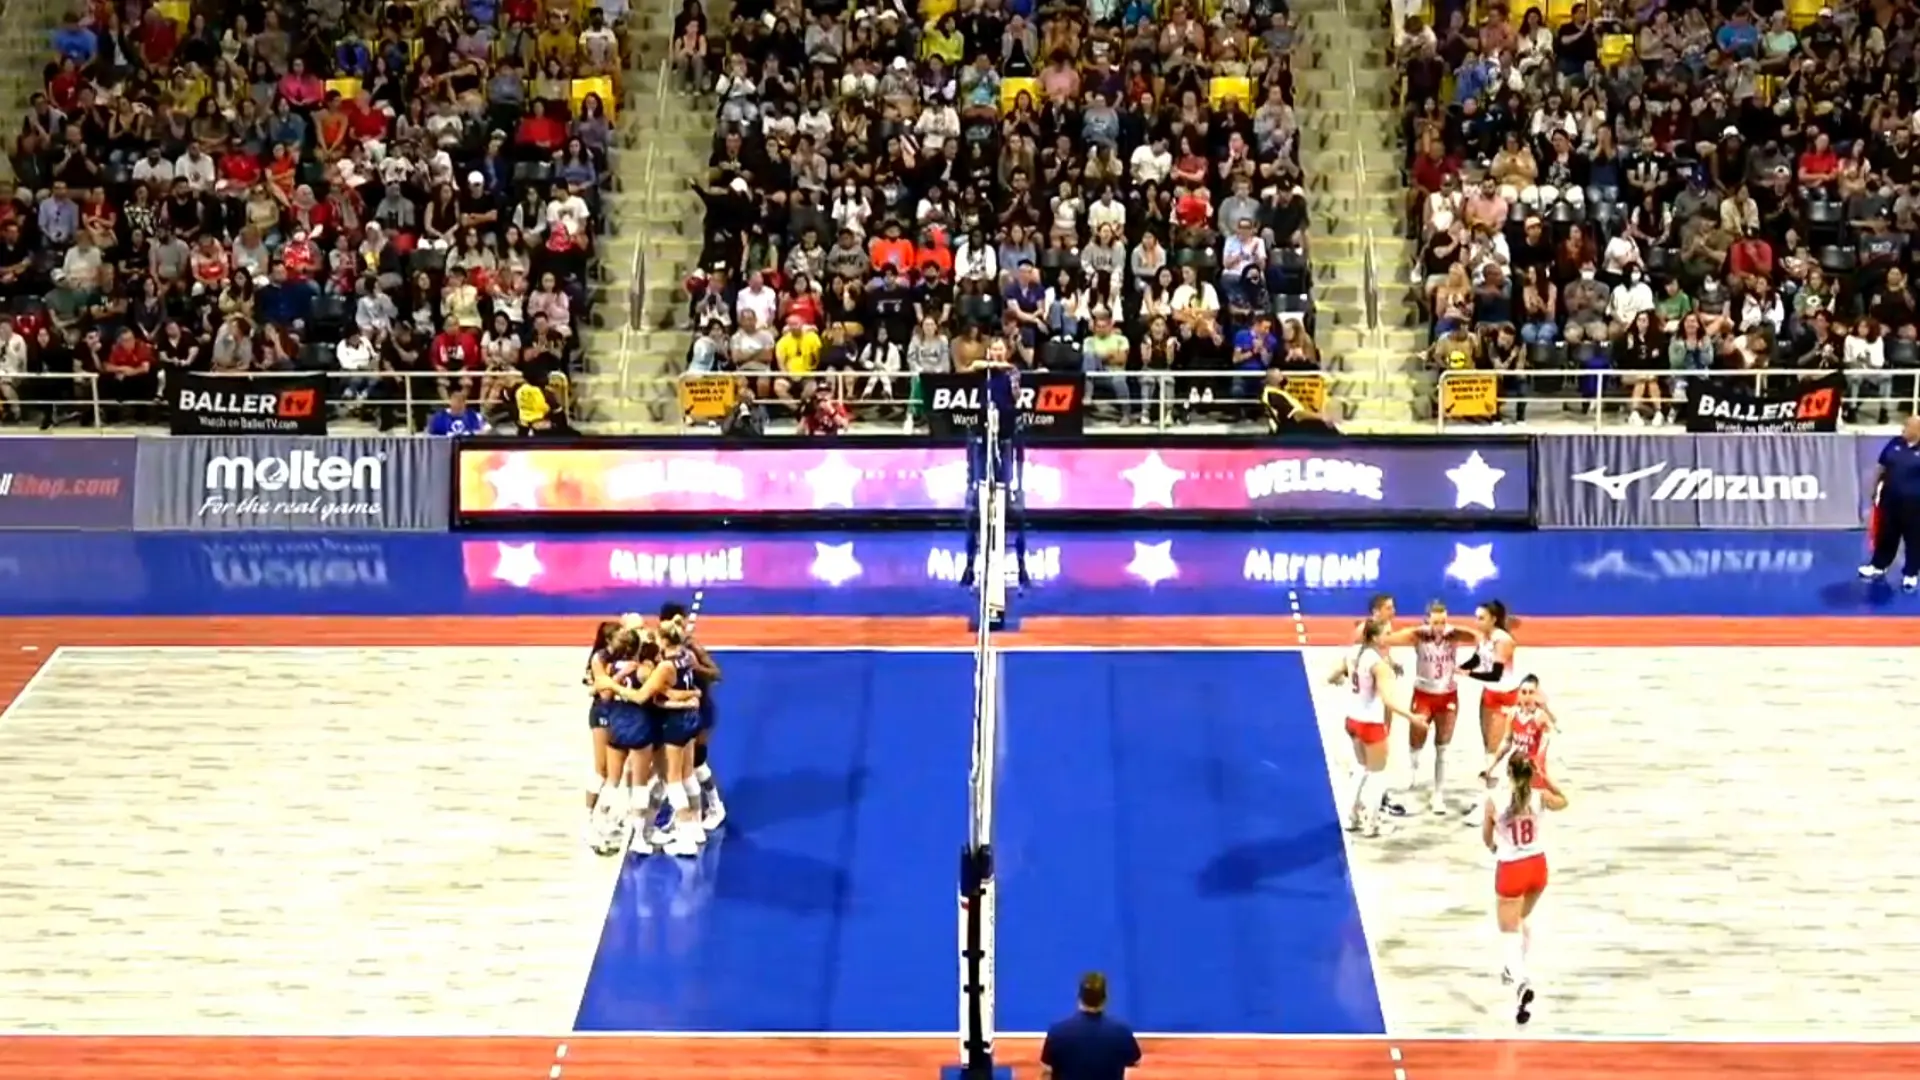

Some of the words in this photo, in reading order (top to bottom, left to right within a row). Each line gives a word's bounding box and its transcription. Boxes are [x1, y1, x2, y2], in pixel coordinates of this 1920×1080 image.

[179, 389, 277, 414] BALLER
[932, 387, 1036, 410] BALR
[1698, 394, 1797, 421] BALLER
[198, 416, 227, 429] Watch
[228, 420, 239, 429] on
[206, 449, 382, 491] molten
[1244, 457, 1384, 501] WELCOME
[198, 495, 235, 517] For
[236, 495, 271, 514] the
[273, 495, 322, 515] real
[320, 502, 382, 522] game
[1505, 818, 1534, 846] 18
